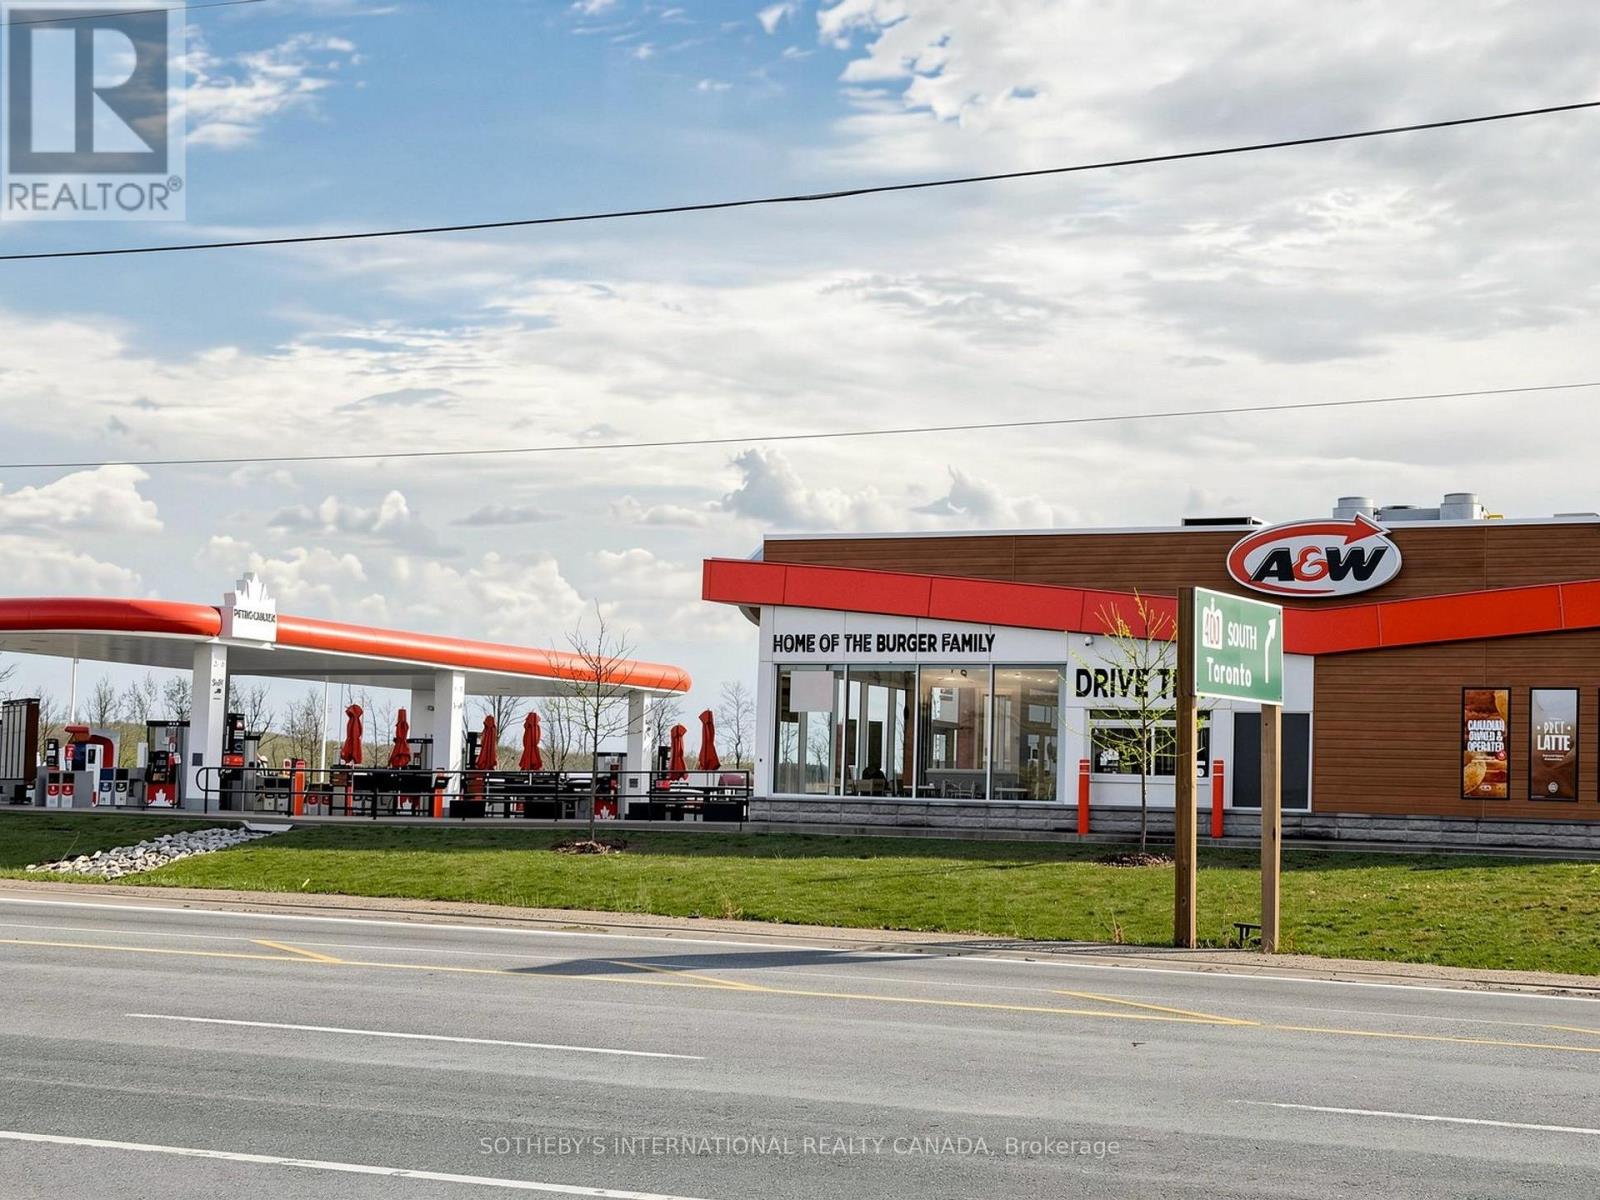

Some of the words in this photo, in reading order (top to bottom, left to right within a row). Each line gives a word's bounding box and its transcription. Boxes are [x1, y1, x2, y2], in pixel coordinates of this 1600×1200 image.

[1250, 545, 1388, 582] A&W
[773, 633, 815, 653] HOME
[819, 633, 840, 653] OF
[844, 633, 872, 653] THE
[876, 633, 937, 653] BURGER
[942, 633, 995, 653] FAMILY
[1227, 621, 1257, 650] SOUTH
[1075, 668, 1148, 698] DRIVE
[1206, 656, 1252, 687] Toronto
[1537, 735, 1571, 751] LATTE
